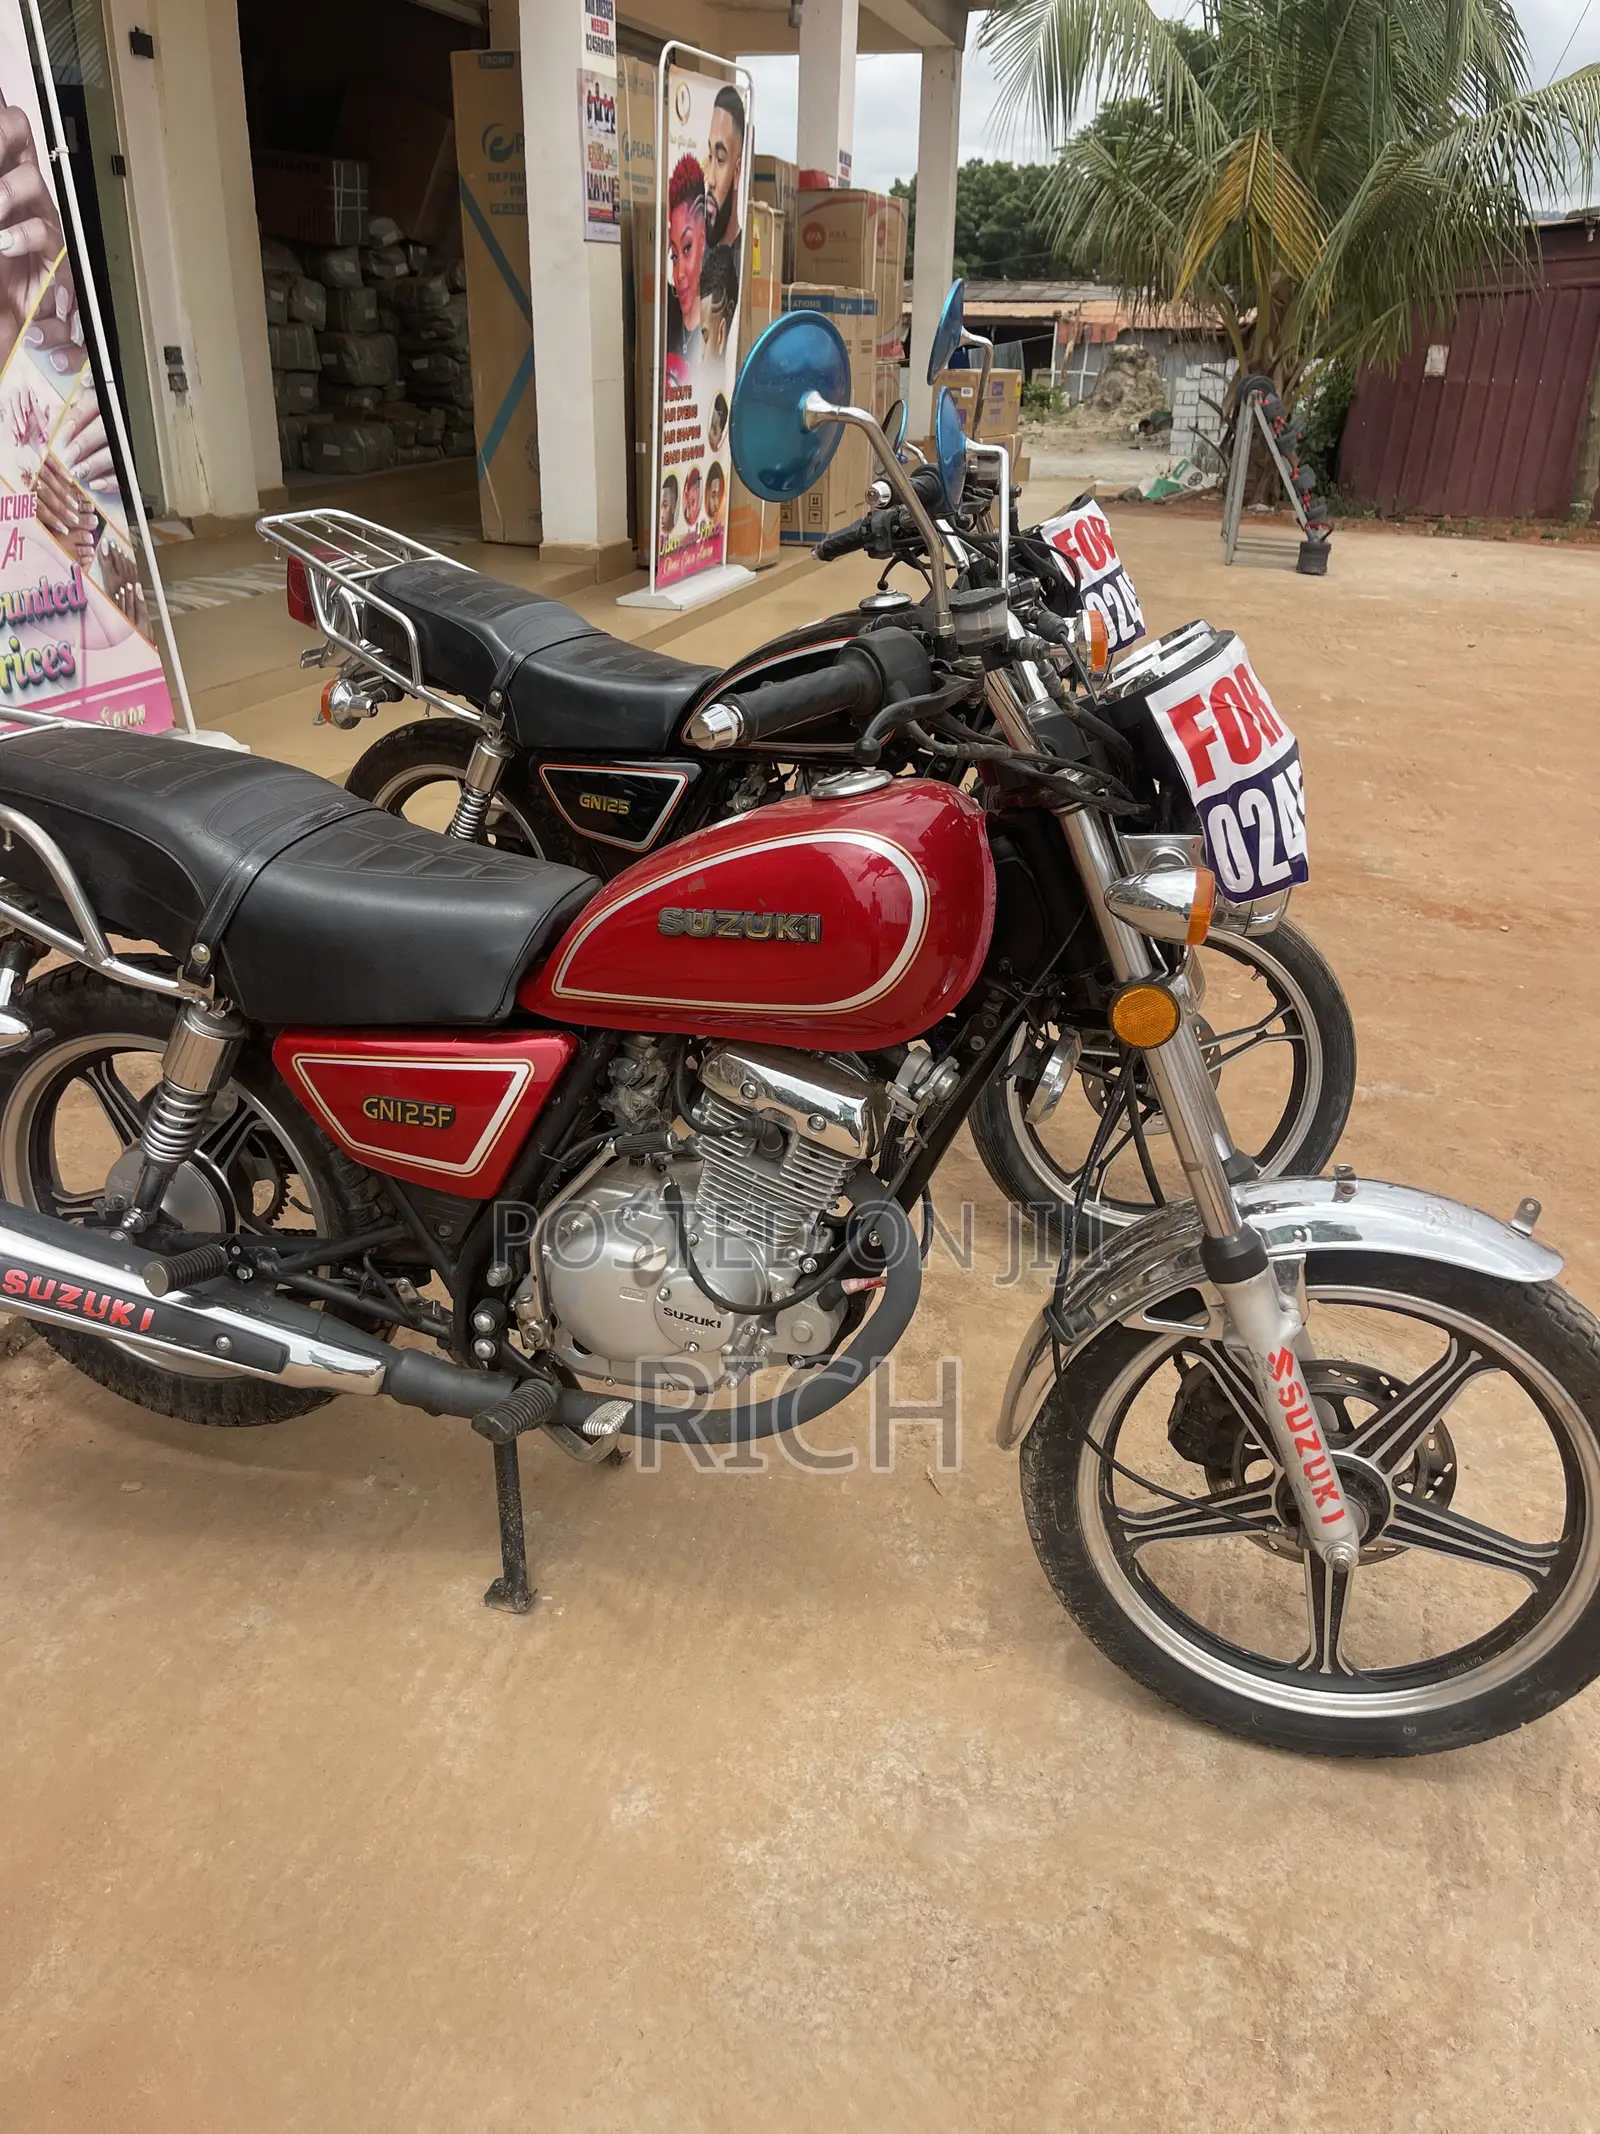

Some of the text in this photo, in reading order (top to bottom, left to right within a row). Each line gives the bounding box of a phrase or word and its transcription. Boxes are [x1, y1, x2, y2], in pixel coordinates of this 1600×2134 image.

[1052, 515, 1116, 580] FOR
[1166, 663, 1284, 788] FOR
[578, 793, 631, 815] GN125
[657, 907, 822, 943] SUZUKI
[362, 1097, 456, 1129] GN125F
[2, 1269, 155, 1331] SUZUKI
[663, 1307, 722, 1329] SUZUKI
[1277, 1380, 1346, 1525] SUZUKI
